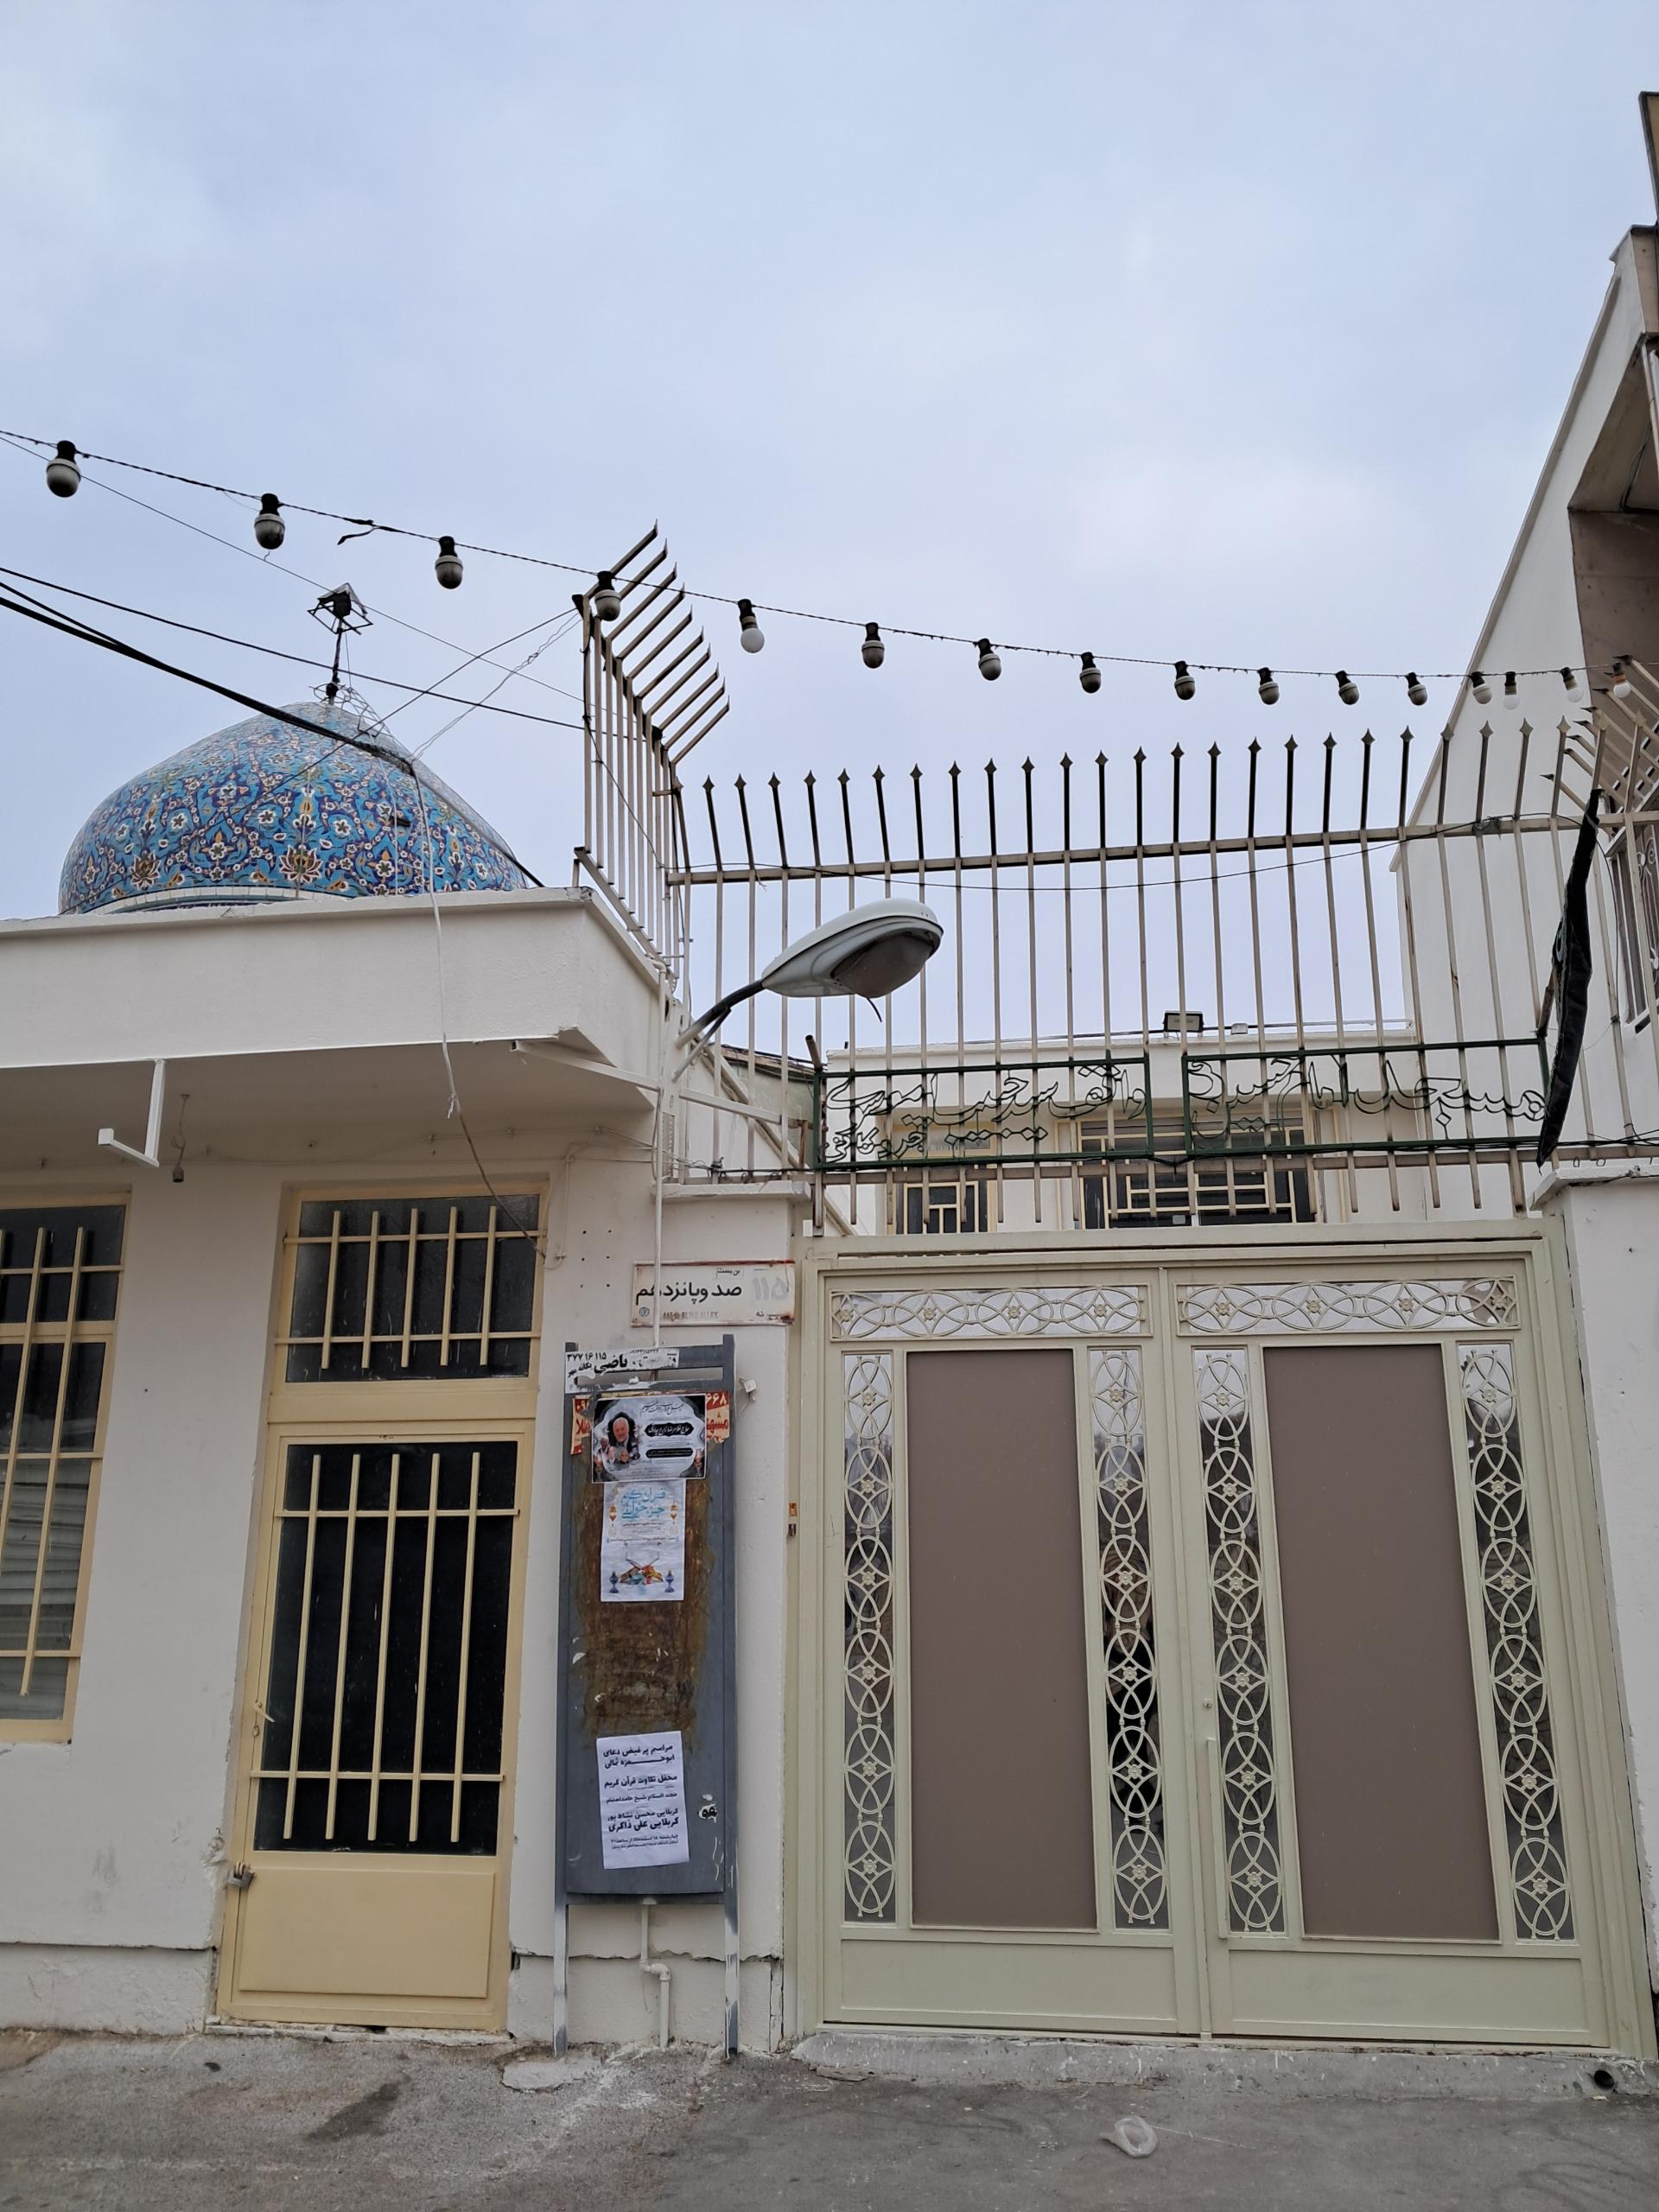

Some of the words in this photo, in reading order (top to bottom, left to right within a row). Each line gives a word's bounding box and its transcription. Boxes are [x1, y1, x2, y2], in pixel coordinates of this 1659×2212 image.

[711, 1284, 742, 1297] صد
[622, 1746, 641, 1757] فیض
[651, 1744, 673, 1755] مراسم
[604, 1778, 620, 1789] کریم
[620, 1776, 636, 1787] قرآن
[638, 1776, 656, 1785] تلاوت
[658, 1774, 677, 1783] محفل
[608, 1819, 632, 1833] ذاکری
[633, 1820, 648, 1831] علی
[650, 1816, 679, 1830] کربلایی
